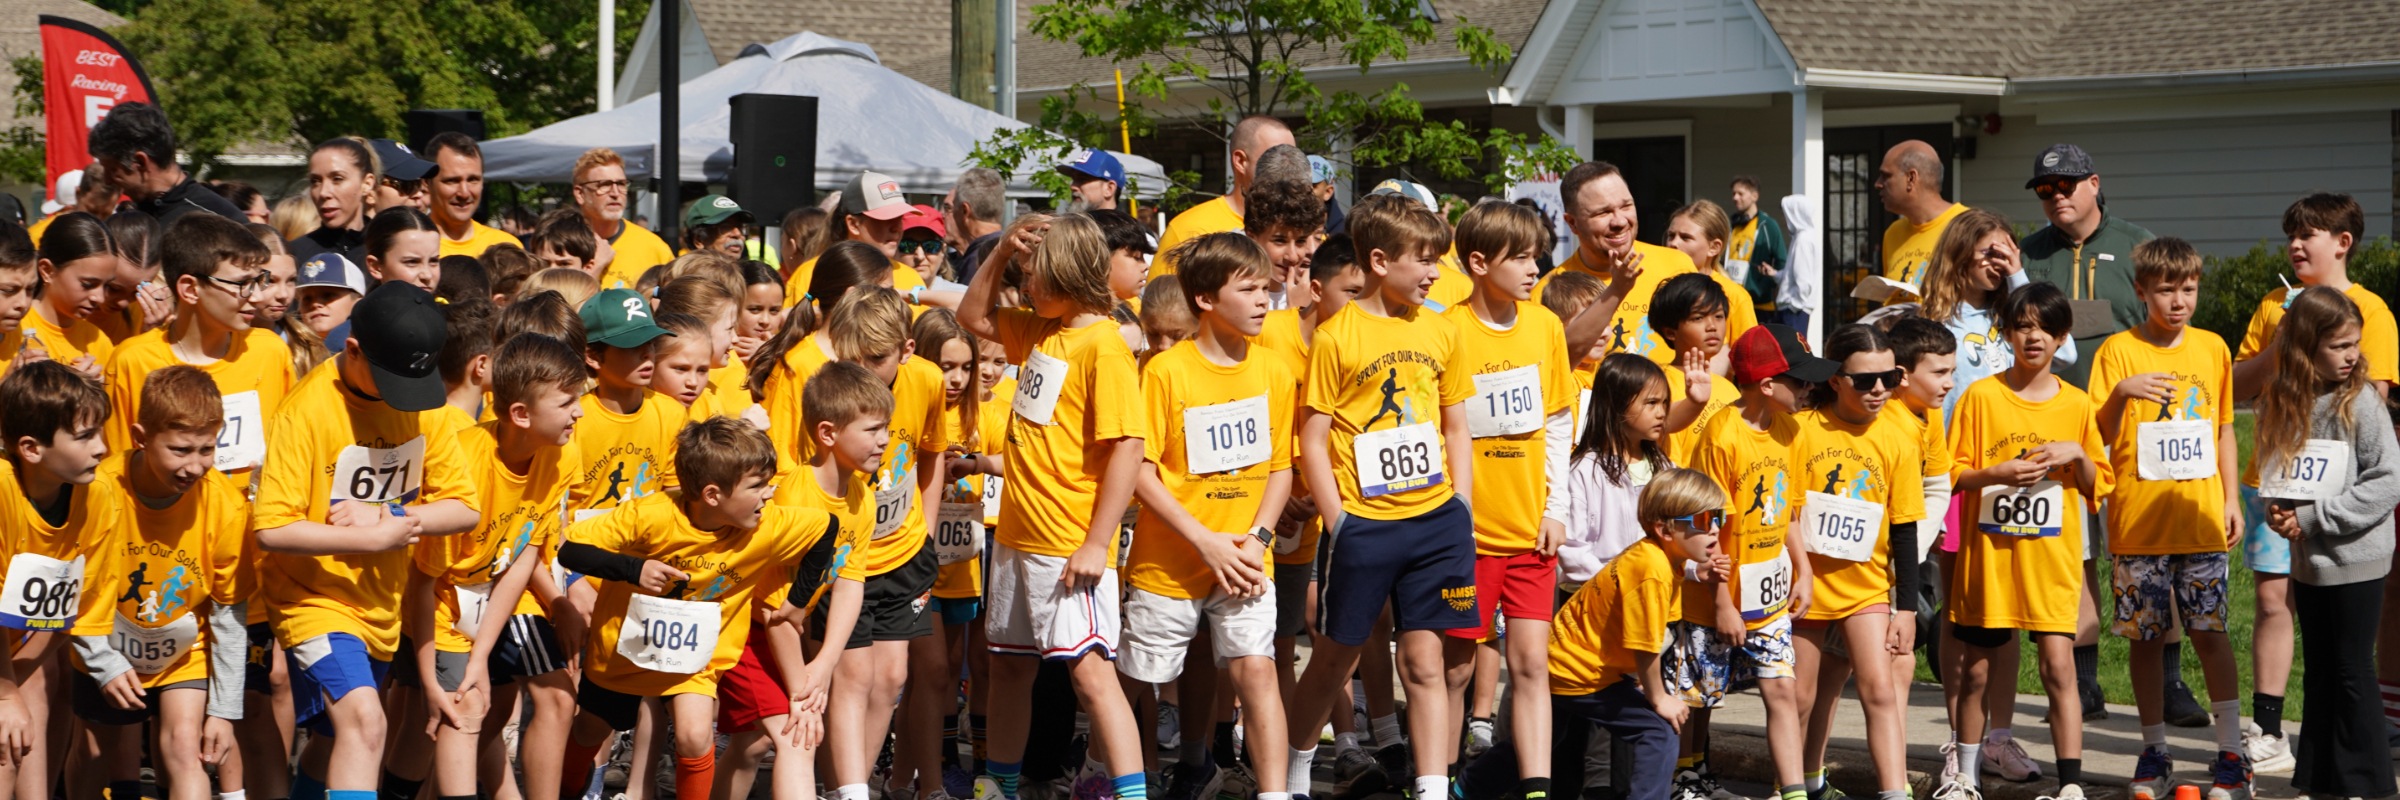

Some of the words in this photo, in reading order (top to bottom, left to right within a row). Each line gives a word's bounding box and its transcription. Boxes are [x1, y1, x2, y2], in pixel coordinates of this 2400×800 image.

[75, 49, 122, 67] BEST
[70, 73, 128, 100] Racing
[623, 297, 647, 321] R
[1622, 302, 1639, 311] Our
[1356, 358, 1382, 387] SPRINT
[1382, 350, 1397, 368] FOR
[1398, 350, 1414, 363] OUR
[1485, 362, 1501, 375] For
[1485, 386, 1533, 418] 1150
[1206, 417, 1257, 451] 1018
[1985, 436, 2009, 460] Sprint
[2010, 432, 2026, 444] For
[2028, 432, 2047, 446] Our
[1221, 456, 1235, 464] Fun
[1236, 453, 1250, 461] Run
[1379, 441, 1430, 481] 863
[1826, 447, 1843, 458] For
[1844, 448, 1863, 462] Our
[2157, 437, 2203, 462] 1054
[584, 454, 609, 485] Sprint
[608, 446, 623, 458] For
[625, 442, 643, 455] Our
[1750, 461, 1763, 473] For
[1763, 456, 1777, 467] Our
[350, 458, 411, 500] 671
[1387, 481, 1408, 491] FUN
[1408, 477, 1429, 488] RUN
[1992, 494, 2050, 526] 680
[938, 520, 973, 547] 063
[1818, 511, 1866, 543] 1055
[2000, 525, 2019, 534] FUN
[2020, 526, 2040, 535] RUN
[127, 541, 146, 556] For
[149, 543, 173, 558] Our
[675, 555, 692, 568] For
[695, 555, 715, 570] Our
[20, 577, 79, 617] 986
[1760, 566, 1788, 606] 859
[25, 618, 46, 629] FUN
[48, 618, 65, 629] RUN
[641, 617, 699, 651] 1084
[118, 632, 177, 661] 1053
[666, 657, 682, 666] Run
